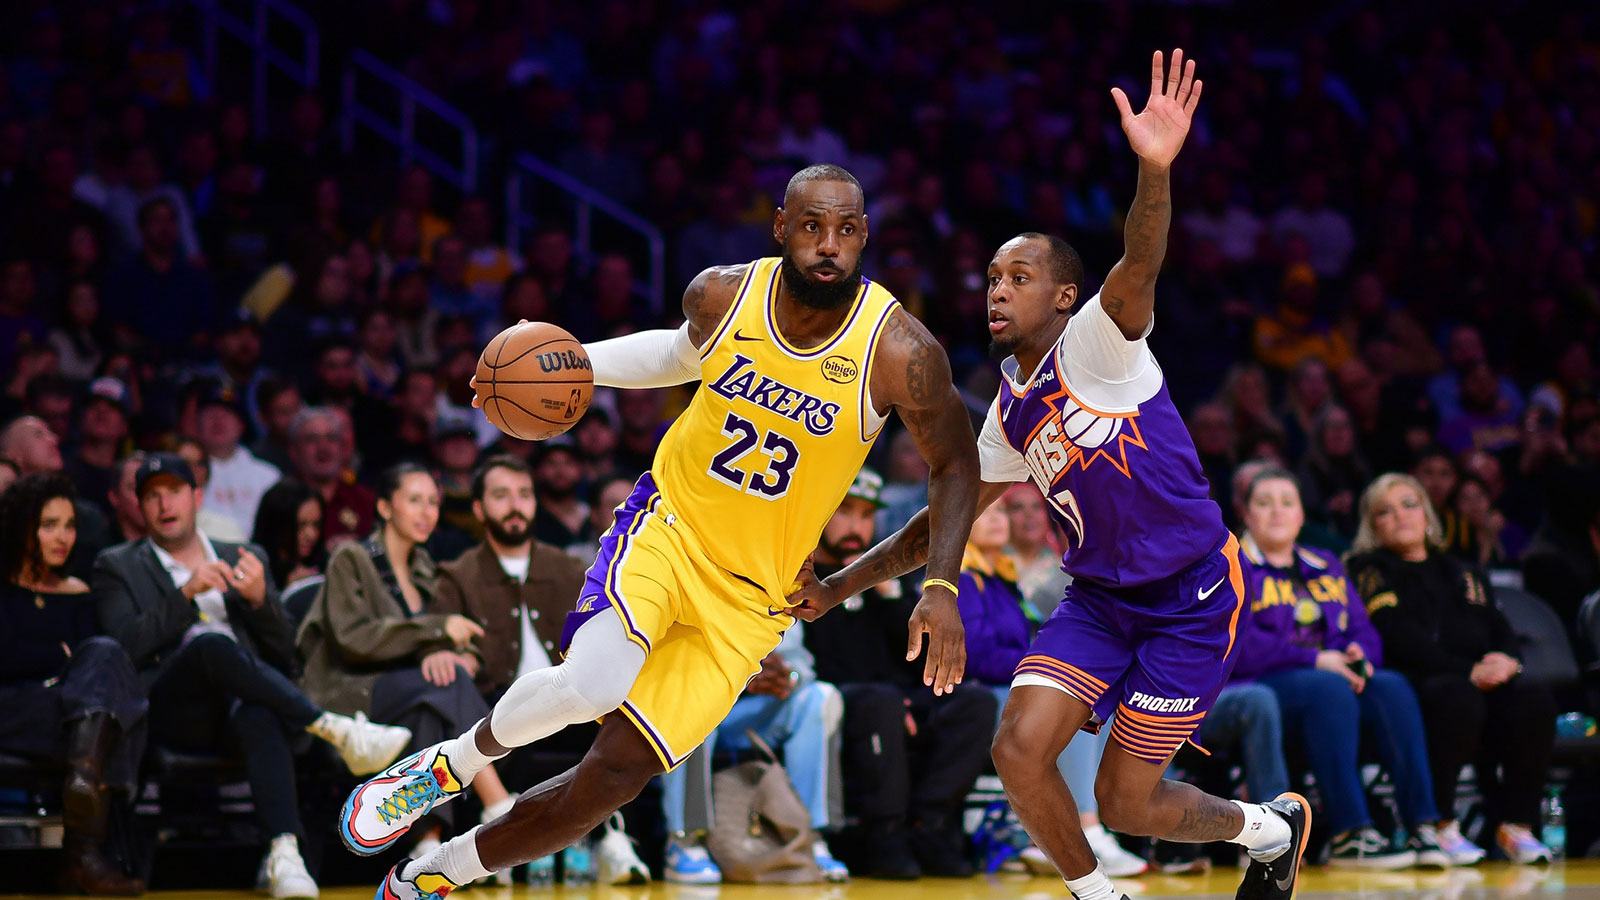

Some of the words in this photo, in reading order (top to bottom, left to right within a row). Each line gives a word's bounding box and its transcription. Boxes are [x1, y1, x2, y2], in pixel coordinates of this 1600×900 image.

[707, 352, 842, 437] LAKERS
[825, 360, 856, 377] bibigo
[706, 410, 801, 502] 23
[1024, 419, 1068, 499] UNS
[1128, 691, 1200, 713] PHOENIX
